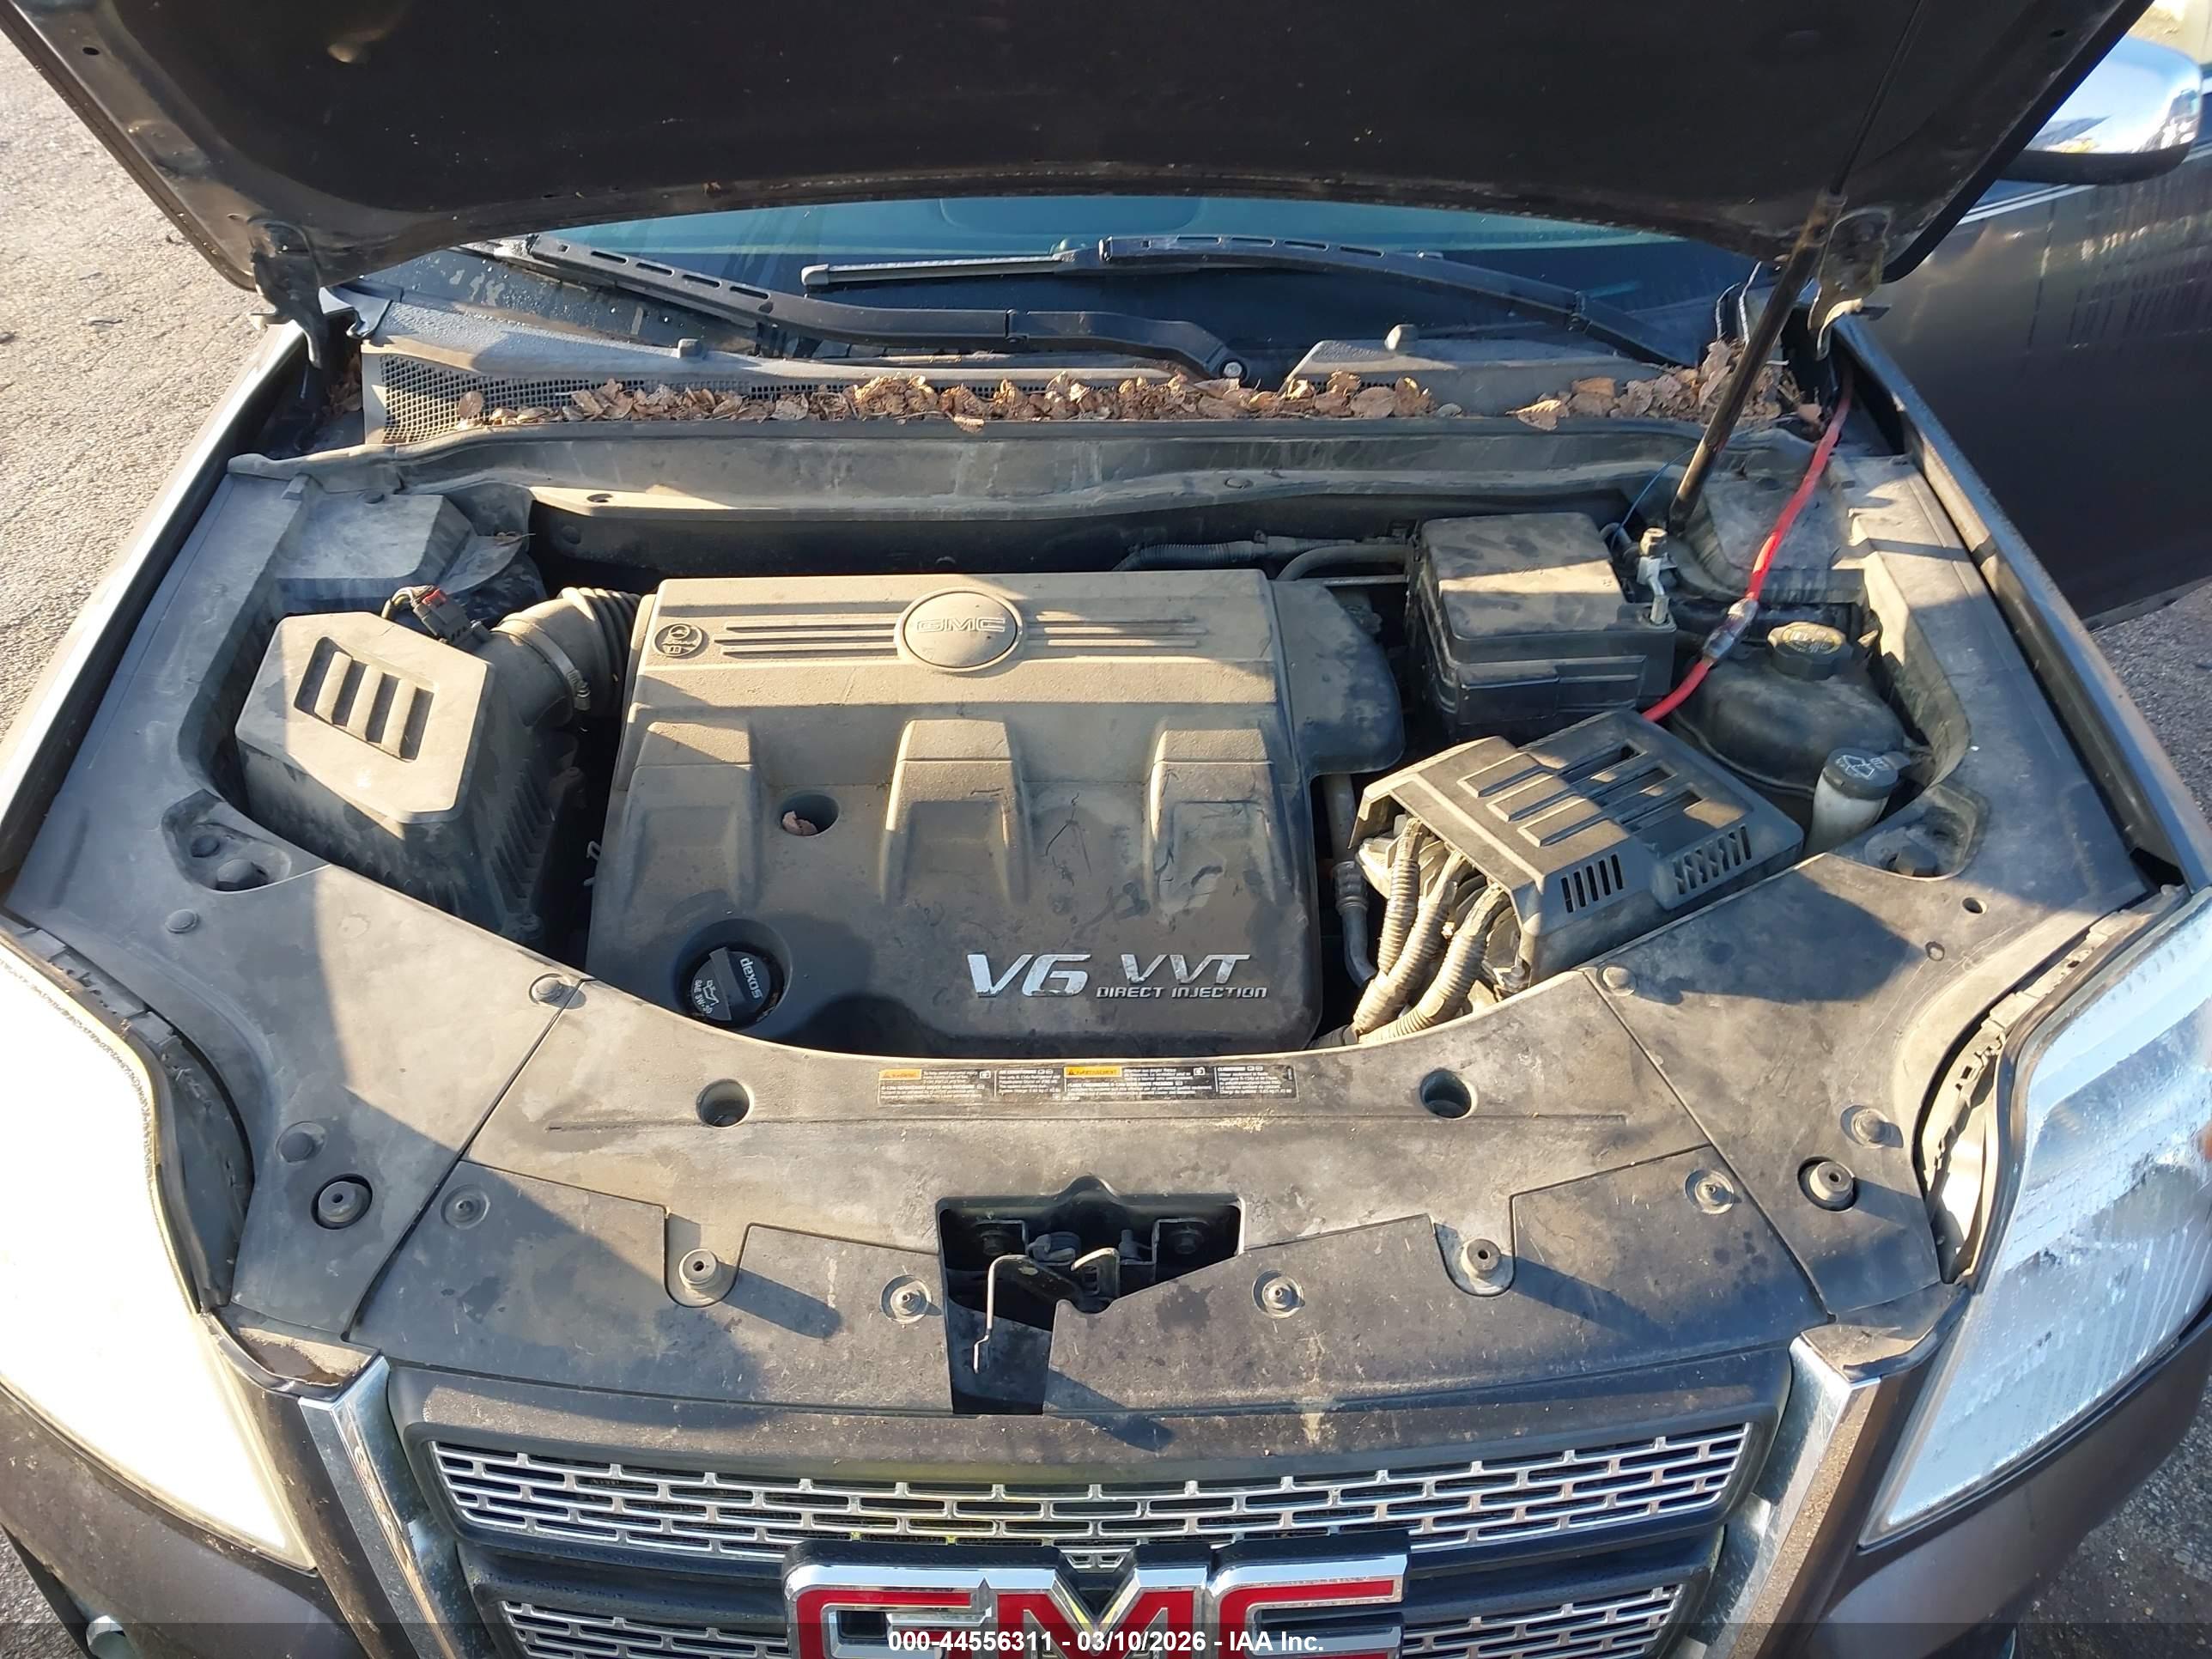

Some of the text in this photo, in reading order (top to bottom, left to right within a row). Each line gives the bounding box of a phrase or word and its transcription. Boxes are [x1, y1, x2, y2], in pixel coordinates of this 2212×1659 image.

[918, 617, 1006, 633] GMC
[740, 957, 763, 999] dexos
[967, 953, 1251, 998] V6 VVT
[1096, 987, 1267, 999] DIRECT INJECTION
[694, 980, 713, 1014] SAE 5W-30
[783, 1551, 1410, 1659] GMC
